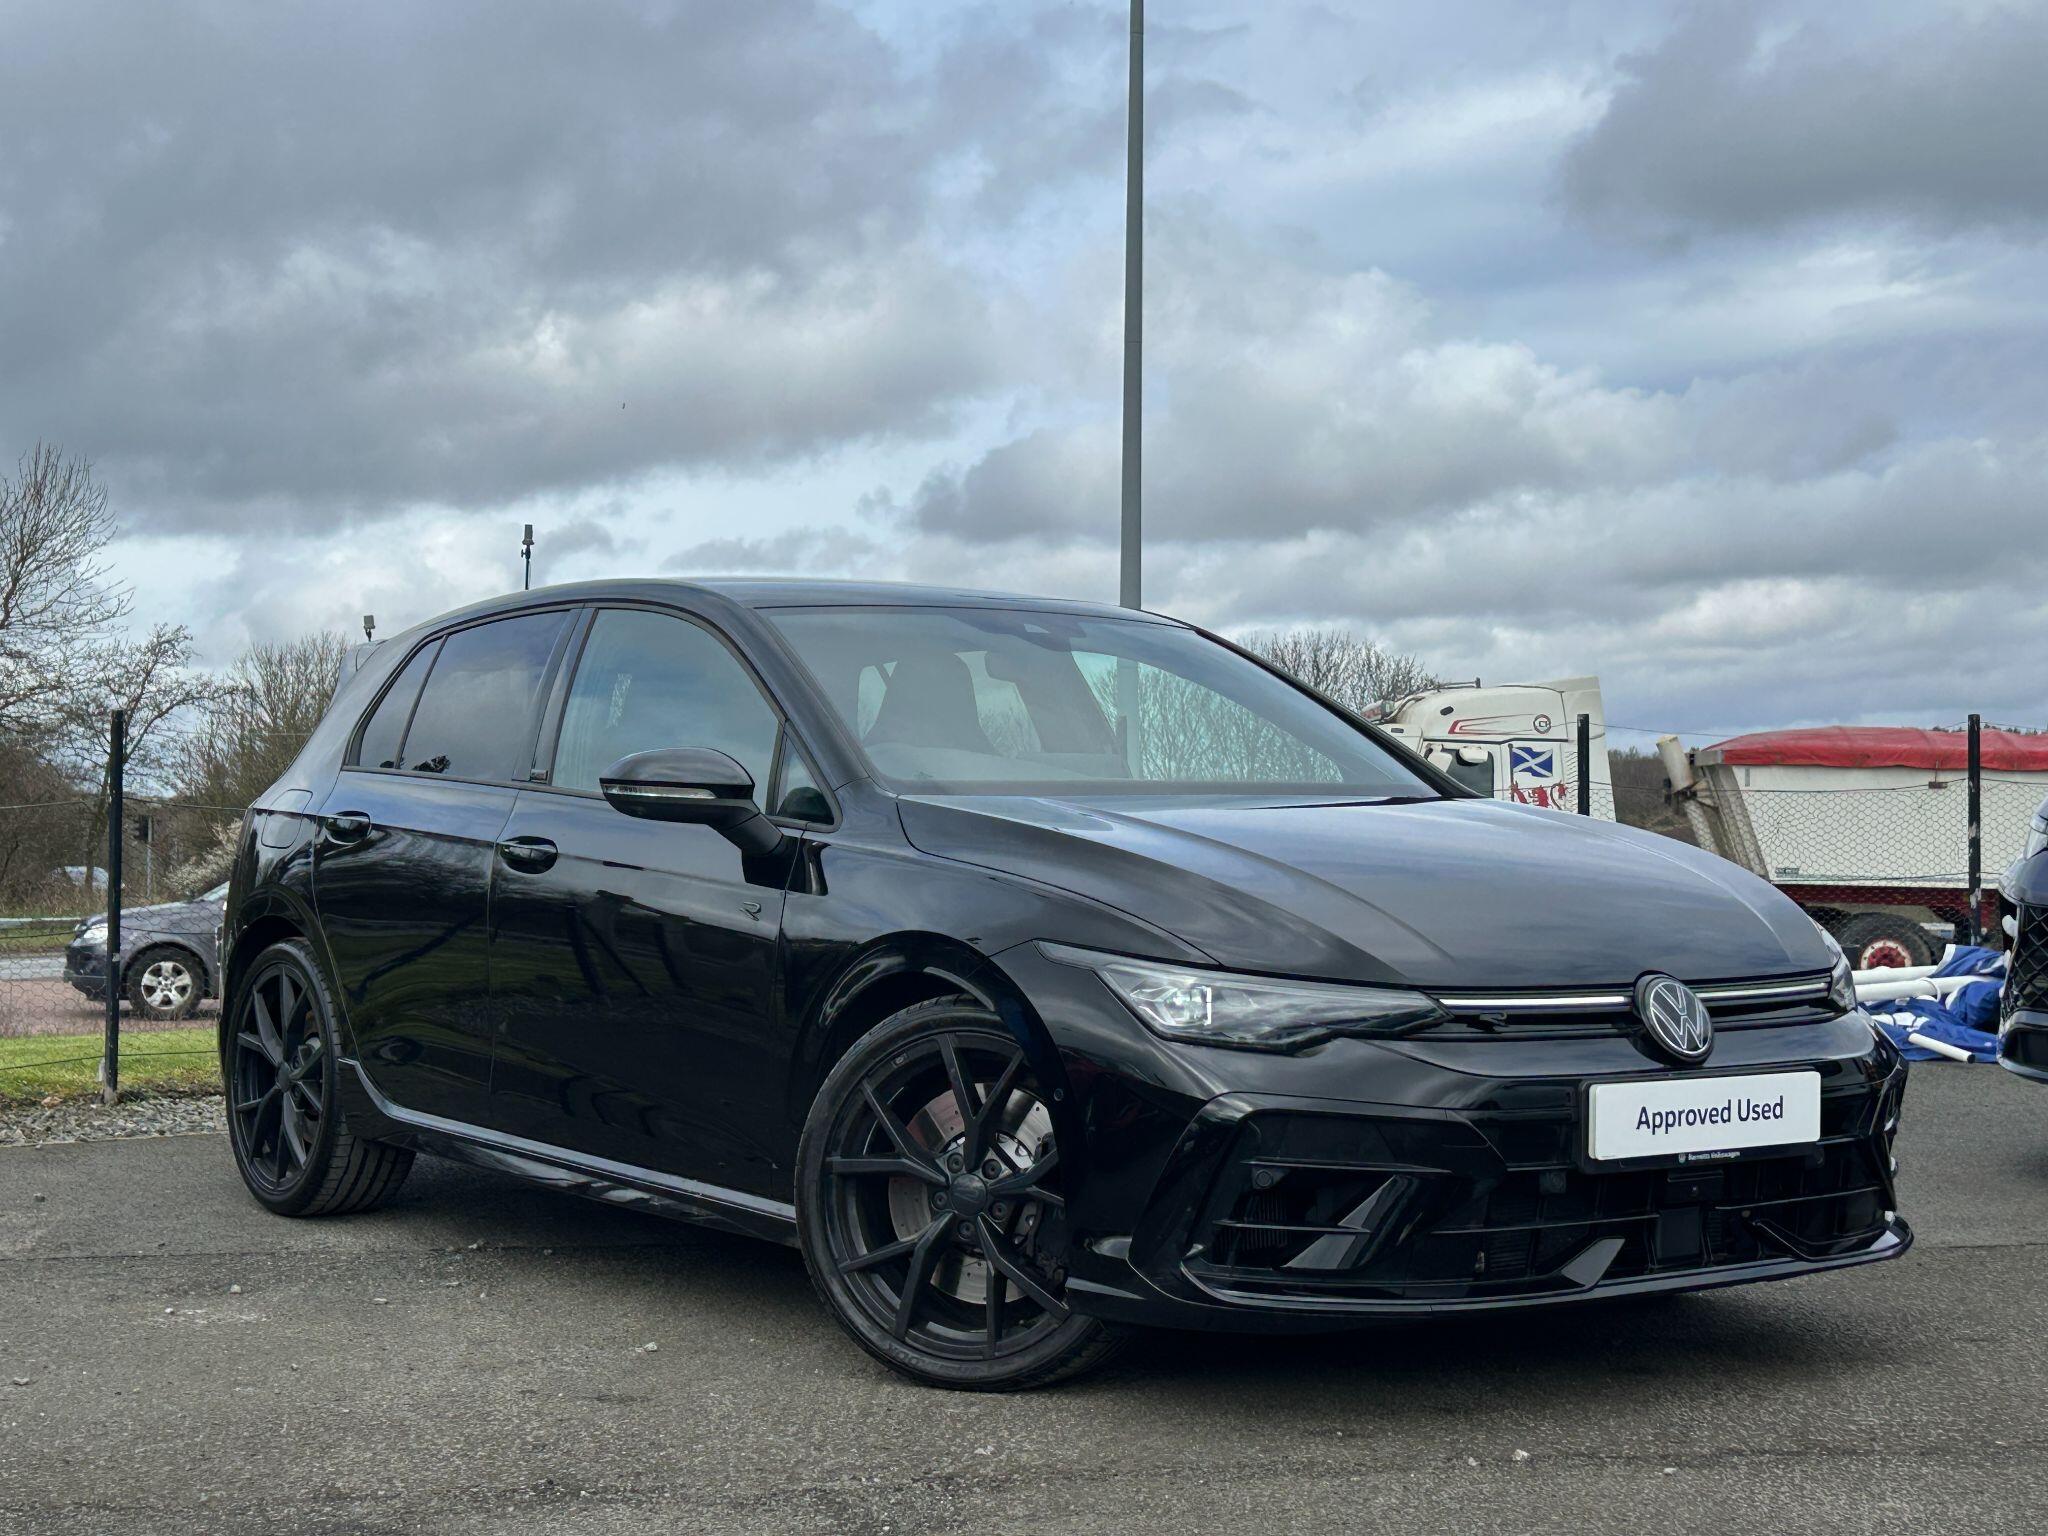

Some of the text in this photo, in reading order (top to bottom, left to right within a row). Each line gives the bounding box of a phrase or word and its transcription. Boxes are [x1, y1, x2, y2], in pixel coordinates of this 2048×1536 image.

[1650, 981, 1712, 1054] VW
[1636, 1095, 1784, 1135] Approved Used
